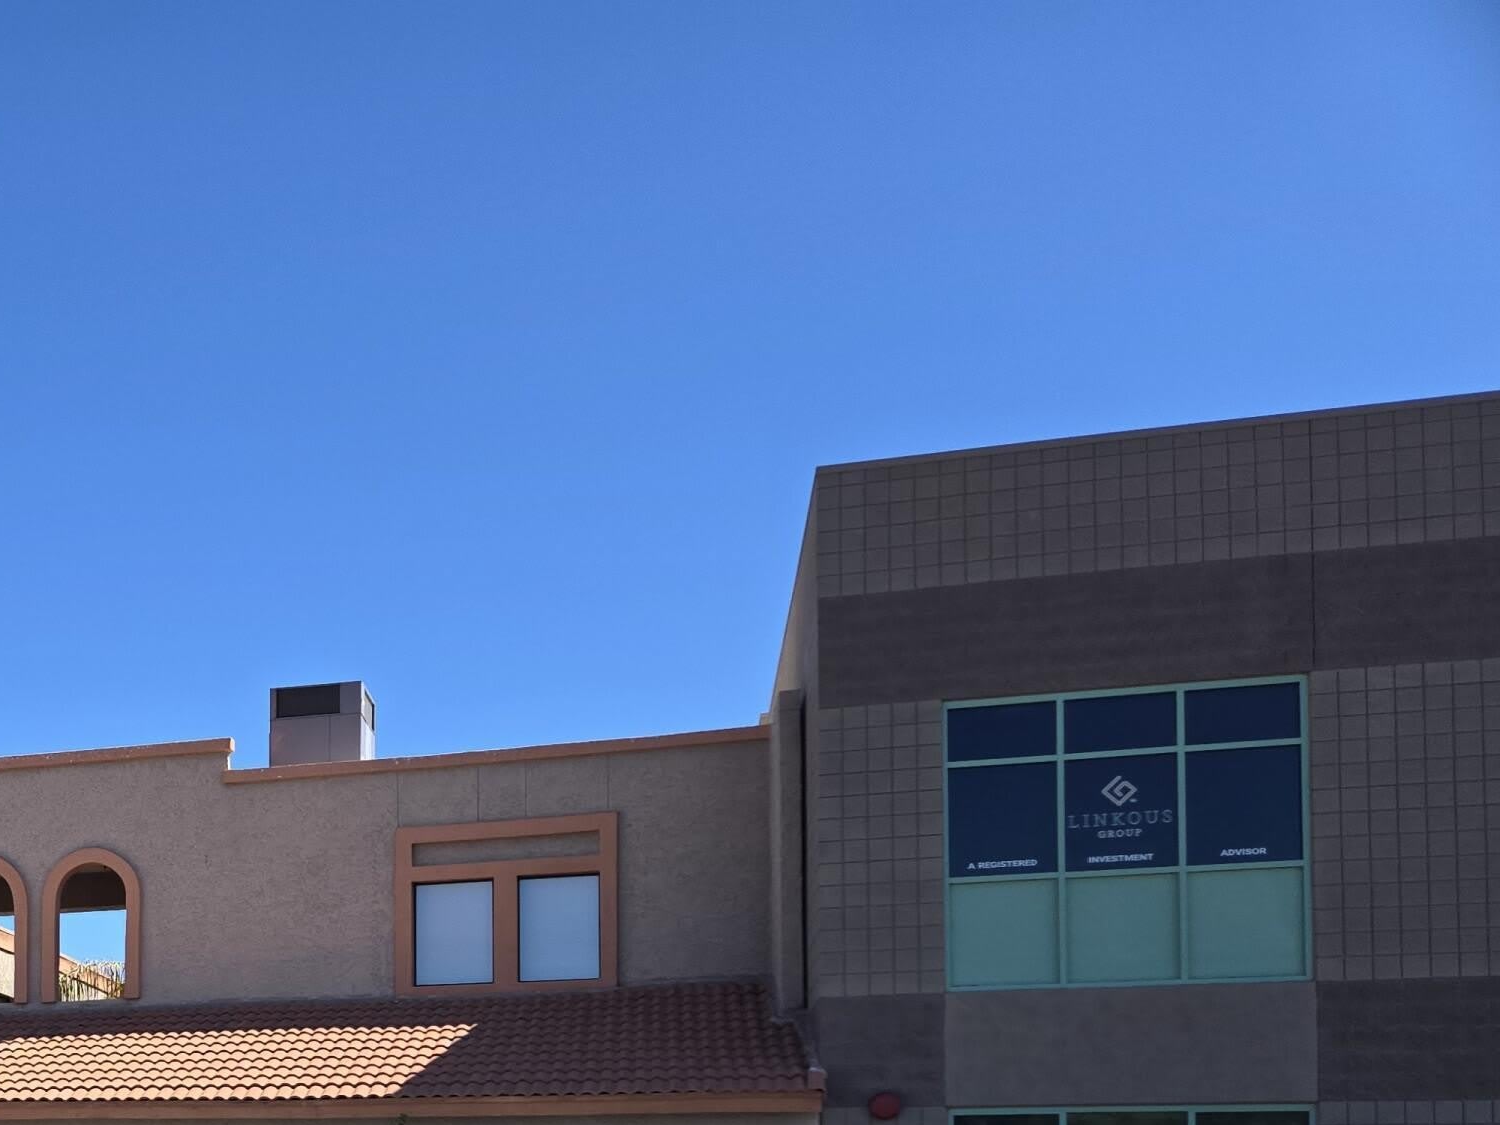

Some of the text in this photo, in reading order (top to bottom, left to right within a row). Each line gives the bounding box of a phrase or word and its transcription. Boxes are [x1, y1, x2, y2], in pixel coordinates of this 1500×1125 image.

[1067, 809, 1173, 829] LINKOUS
[1097, 828, 1142, 839] GROUP
[967, 847, 1267, 870] A REGISTERED INVESTMENT ADVISOR
